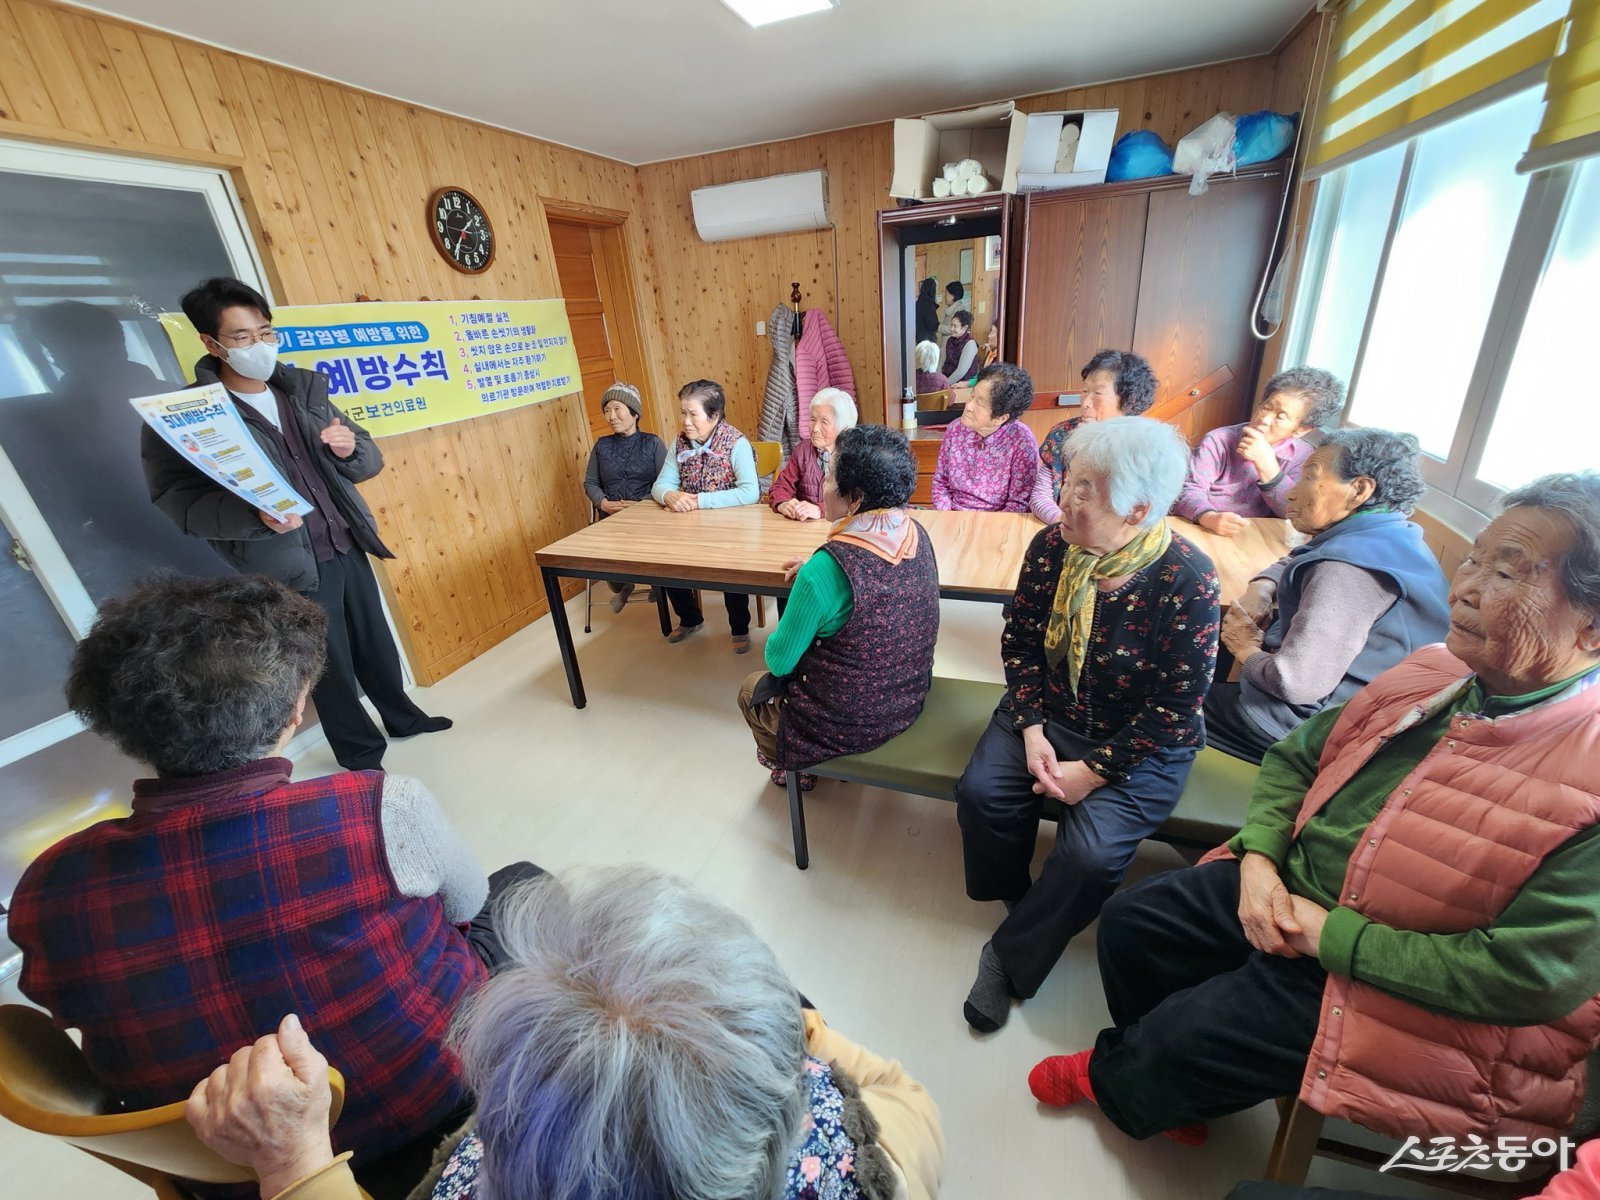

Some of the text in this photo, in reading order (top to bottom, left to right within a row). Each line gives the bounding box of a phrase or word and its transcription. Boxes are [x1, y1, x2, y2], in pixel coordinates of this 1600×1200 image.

[443, 197, 452, 210] 11
[452, 196, 461, 209] 12
[438, 207, 447, 220] 10
[437, 221, 444, 233] 9
[473, 214, 480, 227] 2
[480, 229, 486, 241] 3
[444, 237, 451, 250] 8
[478, 243, 485, 255] 4
[465, 254, 472, 266] 6
[473, 251, 480, 263] 5
[461, 312, 494, 324] 기침예절
[495, 311, 511, 323] 실천
[294, 328, 351, 347] 감염병
[352, 326, 396, 343] 예방을
[396, 324, 423, 340] 위한
[465, 328, 490, 341] 올바른
[490, 325, 520, 339] 손씻기의
[520, 325, 536, 337] 생활화
[470, 344, 486, 357] 씻지
[487, 343, 502, 355] 않은
[504, 341, 524, 354] 손으로
[474, 359, 511, 373] 실내에서는
[511, 356, 524, 367] 자주
[525, 353, 547, 365] 환기하기
[315, 350, 450, 396] 예방수칙
[477, 376, 494, 389] 발열
[494, 374, 502, 385] 및
[503, 371, 523, 384] 호흡기
[481, 388, 510, 402] 의료기관
[510, 382, 534, 397] 방문하여
